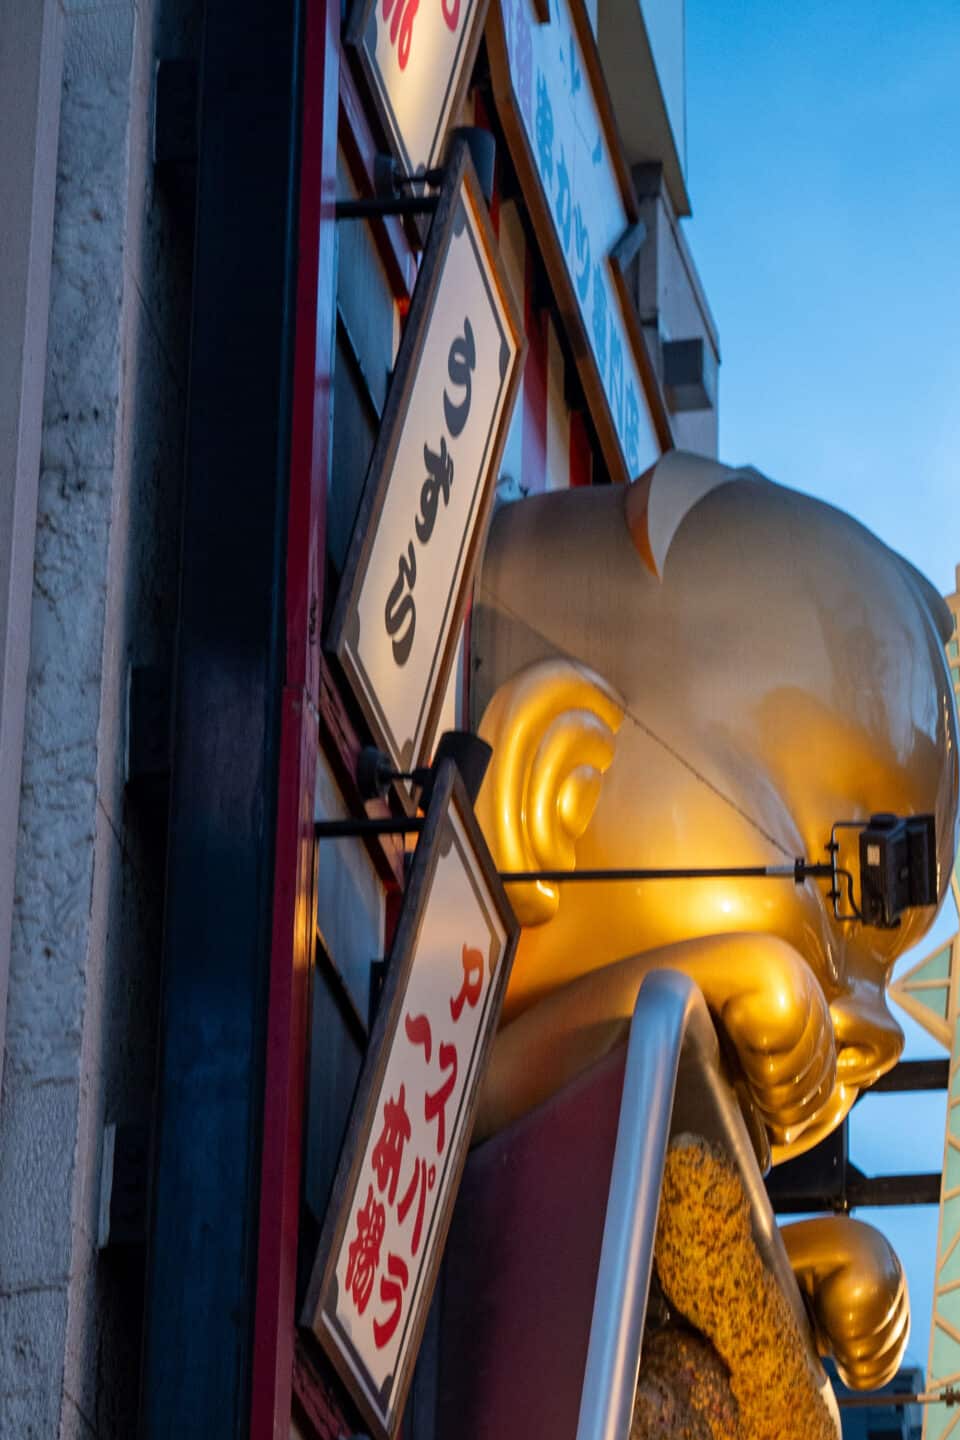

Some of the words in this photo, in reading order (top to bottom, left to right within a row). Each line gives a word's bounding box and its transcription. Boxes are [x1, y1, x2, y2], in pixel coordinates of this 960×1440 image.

[385, 317, 477, 667] うずら
[372, 942, 484, 1350] アスパラ
